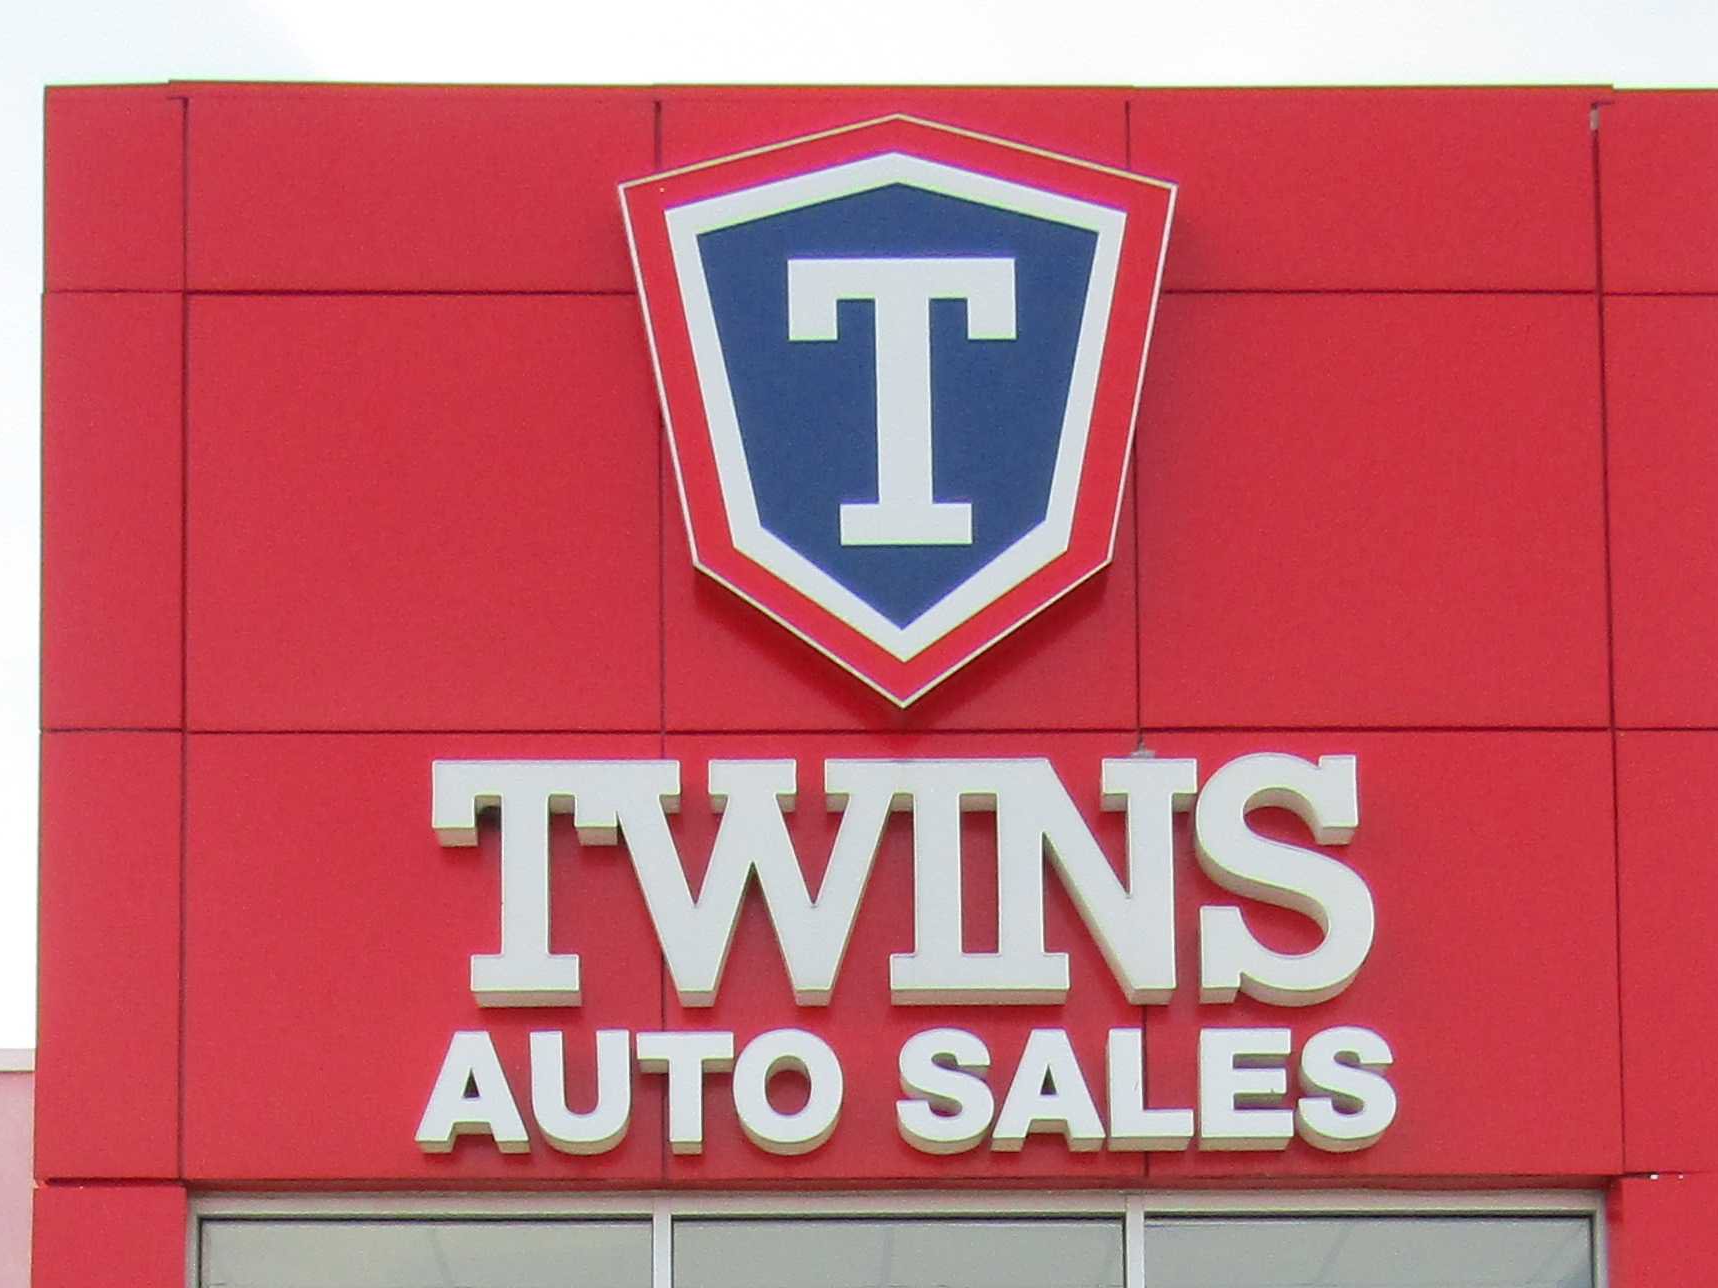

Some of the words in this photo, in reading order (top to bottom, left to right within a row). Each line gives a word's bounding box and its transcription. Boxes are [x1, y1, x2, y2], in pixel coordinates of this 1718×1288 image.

[787, 257, 1017, 546] T
[432, 752, 1375, 1007] TWINS
[415, 1027, 845, 1156] AUTO
[894, 1025, 1399, 1154] SALES
